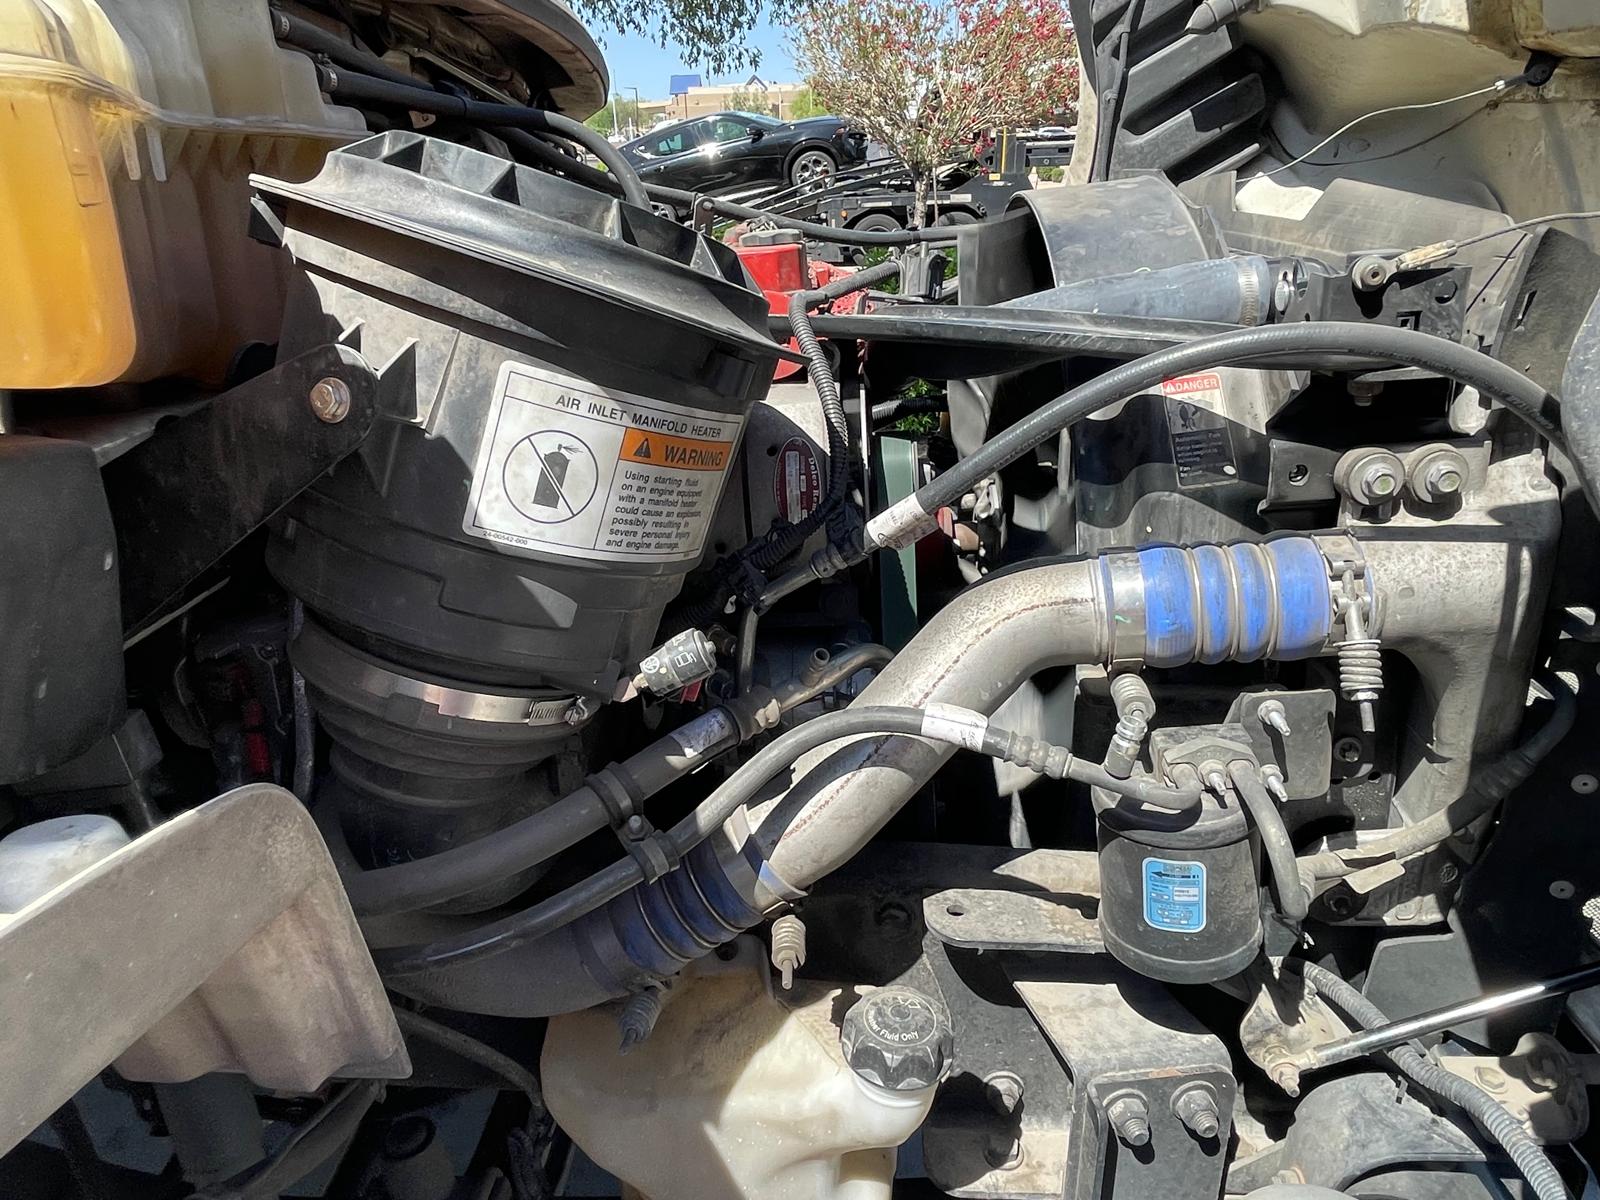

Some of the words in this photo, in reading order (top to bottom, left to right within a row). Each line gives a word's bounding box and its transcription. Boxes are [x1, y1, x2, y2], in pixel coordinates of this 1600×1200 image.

[1176, 378, 1218, 392] DANGER
[555, 394, 581, 410] AIR
[587, 402, 627, 421] INLET
[631, 413, 688, 434] MANIFOLD
[690, 424, 722, 438] HEATER
[664, 444, 724, 466] WARNING
[808, 457, 818, 486] Delco
[625, 470, 650, 484] Using
[654, 475, 682, 488] starting
[685, 478, 699, 487] fluid
[636, 485, 647, 493] an
[649, 487, 674, 497] engine
[618, 494, 636, 502] with
[648, 497, 678, 507] manifold
[615, 506, 639, 515] could
[641, 509, 663, 517] cause
[612, 517, 649, 529] possibly
[651, 520, 681, 530] resulting
[683, 520, 690, 528] in
[609, 528, 638, 537] severe
[641, 531, 673, 540] personal
[606, 539, 623, 547] and
[626, 540, 652, 551] engine
[880, 1029, 900, 1042] Fluid
[901, 1030, 919, 1042] Only
